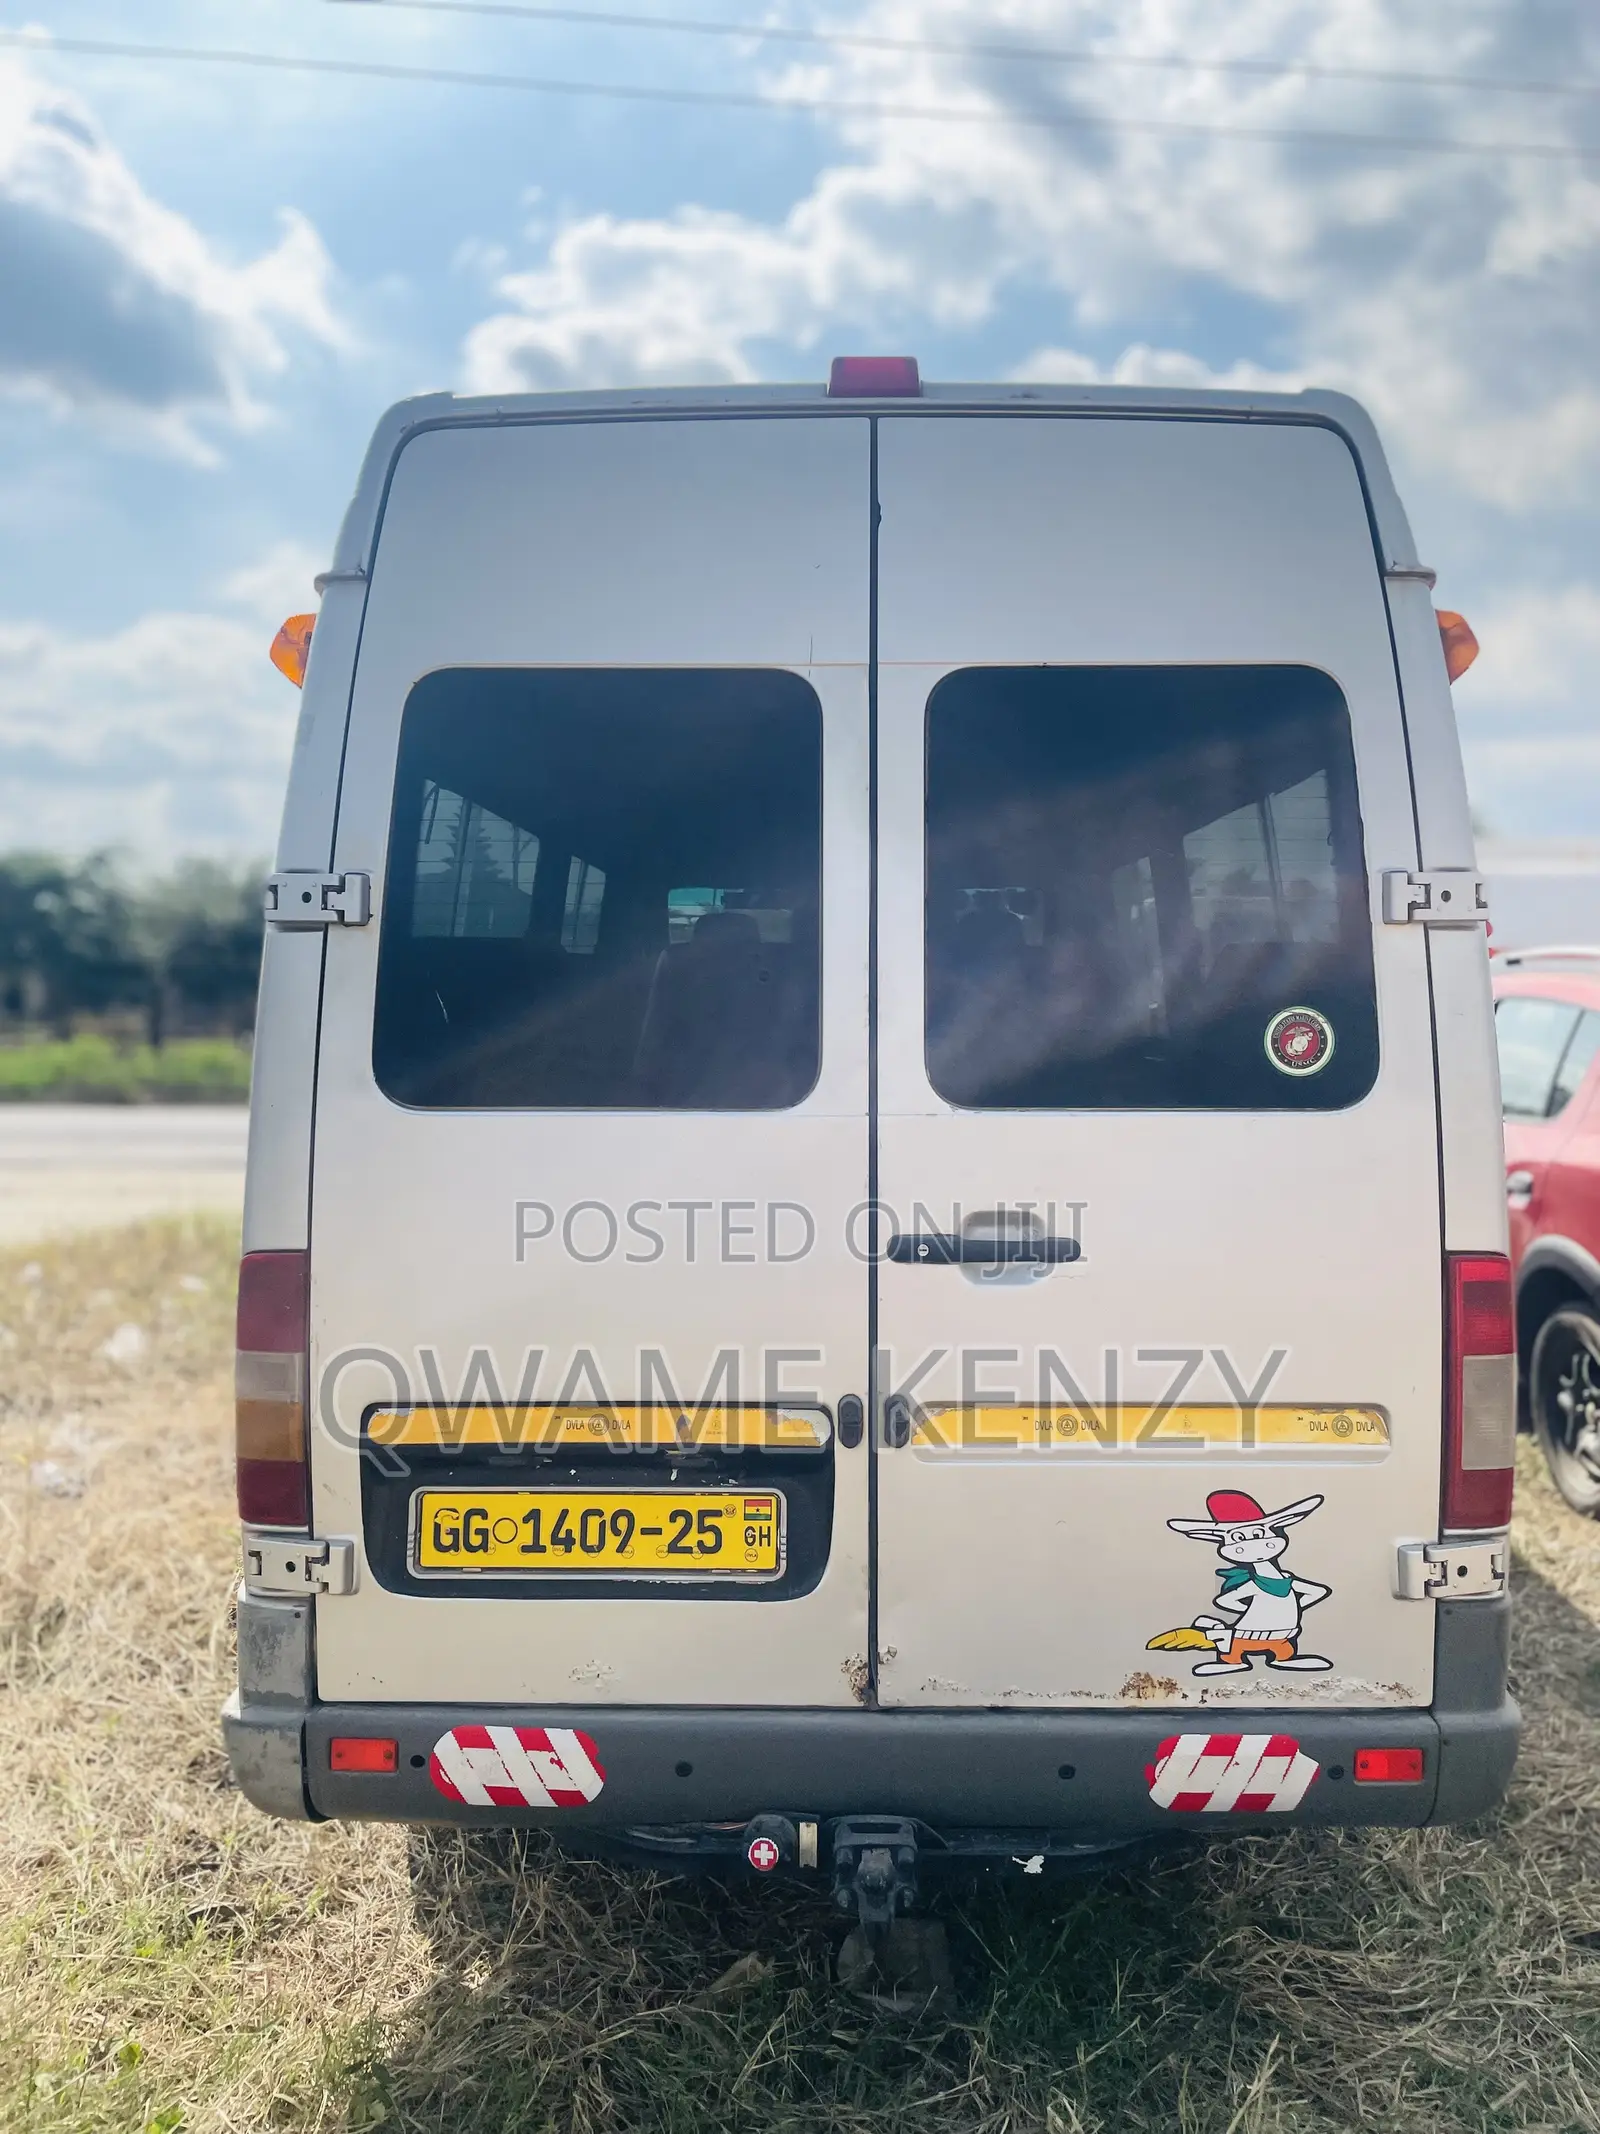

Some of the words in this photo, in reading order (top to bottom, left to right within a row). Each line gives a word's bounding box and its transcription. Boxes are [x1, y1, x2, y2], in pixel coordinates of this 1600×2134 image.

[1291, 1057, 1317, 1067] USMC
[565, 1419, 585, 1431] DVLA
[611, 1419, 632, 1431] DVLA
[1034, 1420, 1054, 1431] DVLA
[1080, 1420, 1101, 1431] DVLA
[1309, 1420, 1329, 1432] DVLA
[1355, 1420, 1376, 1432] DVLA
[433, 1507, 489, 1554] GG
[520, 1508, 724, 1555] 1409-25
[744, 1525, 771, 1547] GH
